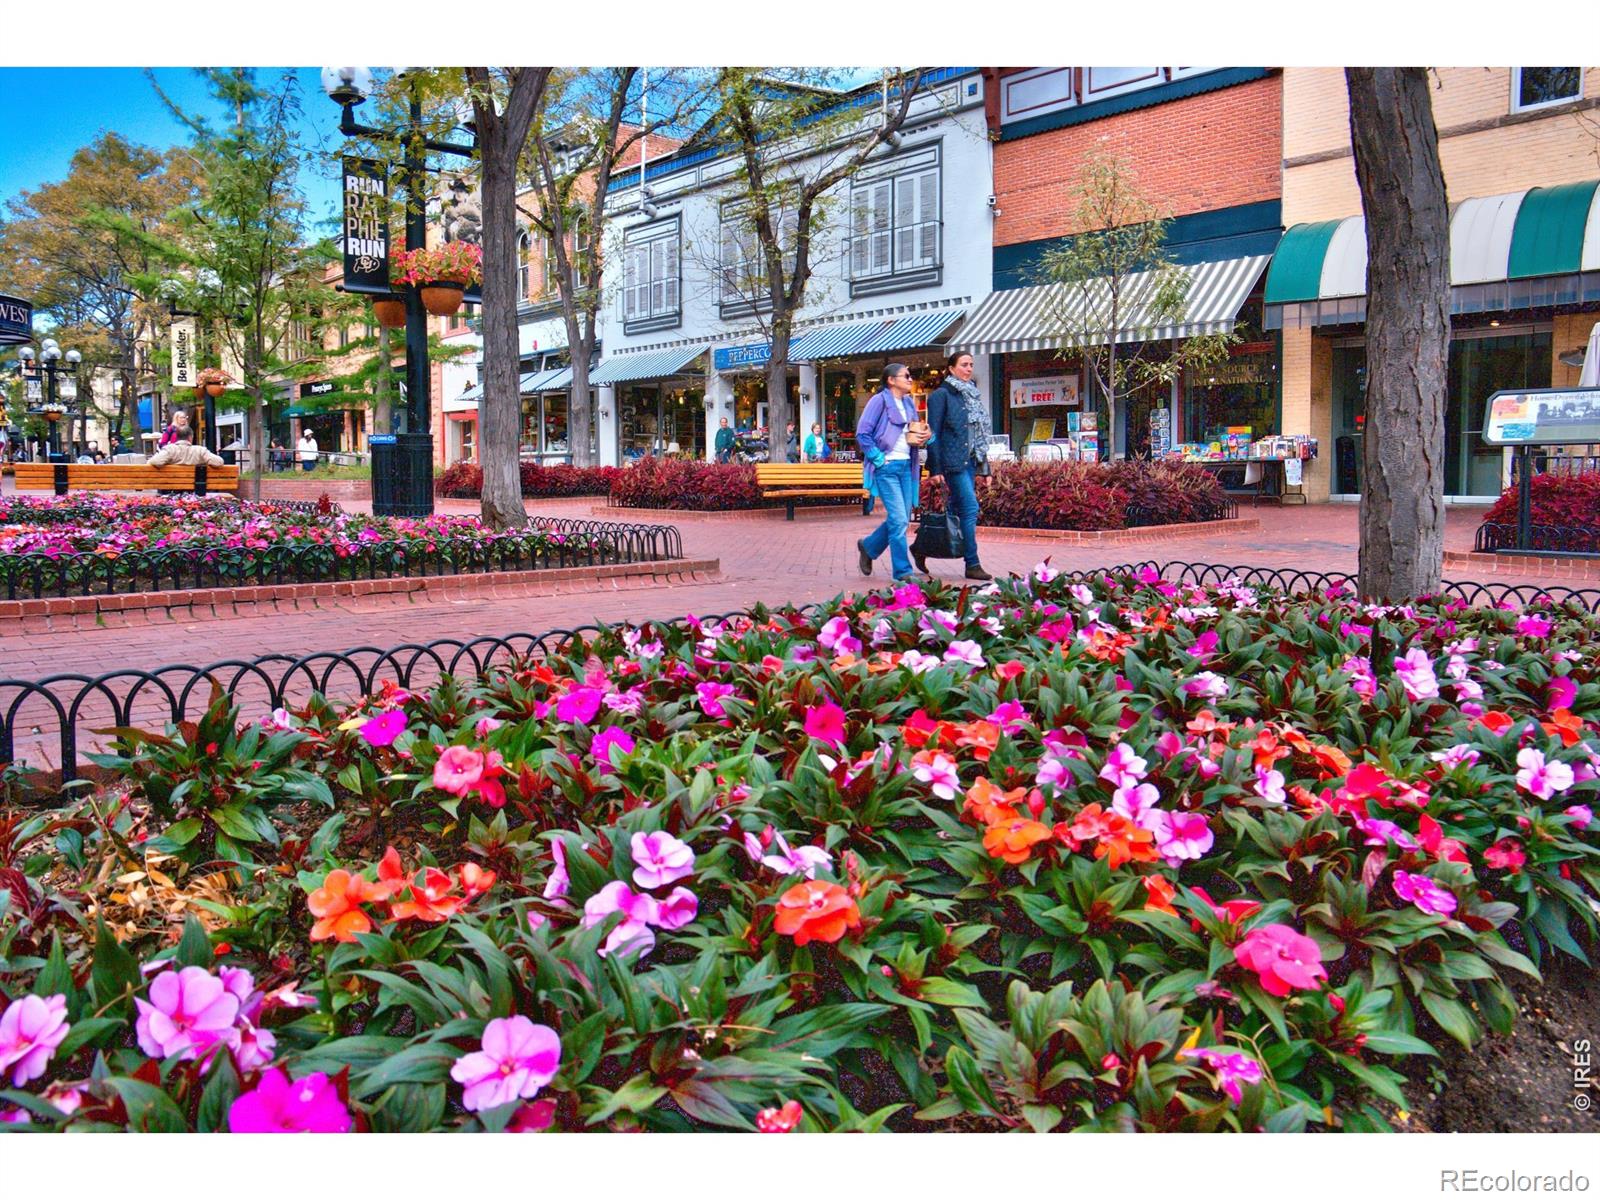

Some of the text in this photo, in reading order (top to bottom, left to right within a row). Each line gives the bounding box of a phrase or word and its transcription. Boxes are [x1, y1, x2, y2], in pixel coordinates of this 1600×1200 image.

[346, 175, 384, 196] RUN
[347, 217, 385, 241] PHIE
[348, 237, 385, 258] RUN
[177, 369, 187, 382] Be
[1031, 392, 1055, 402] FREE!
